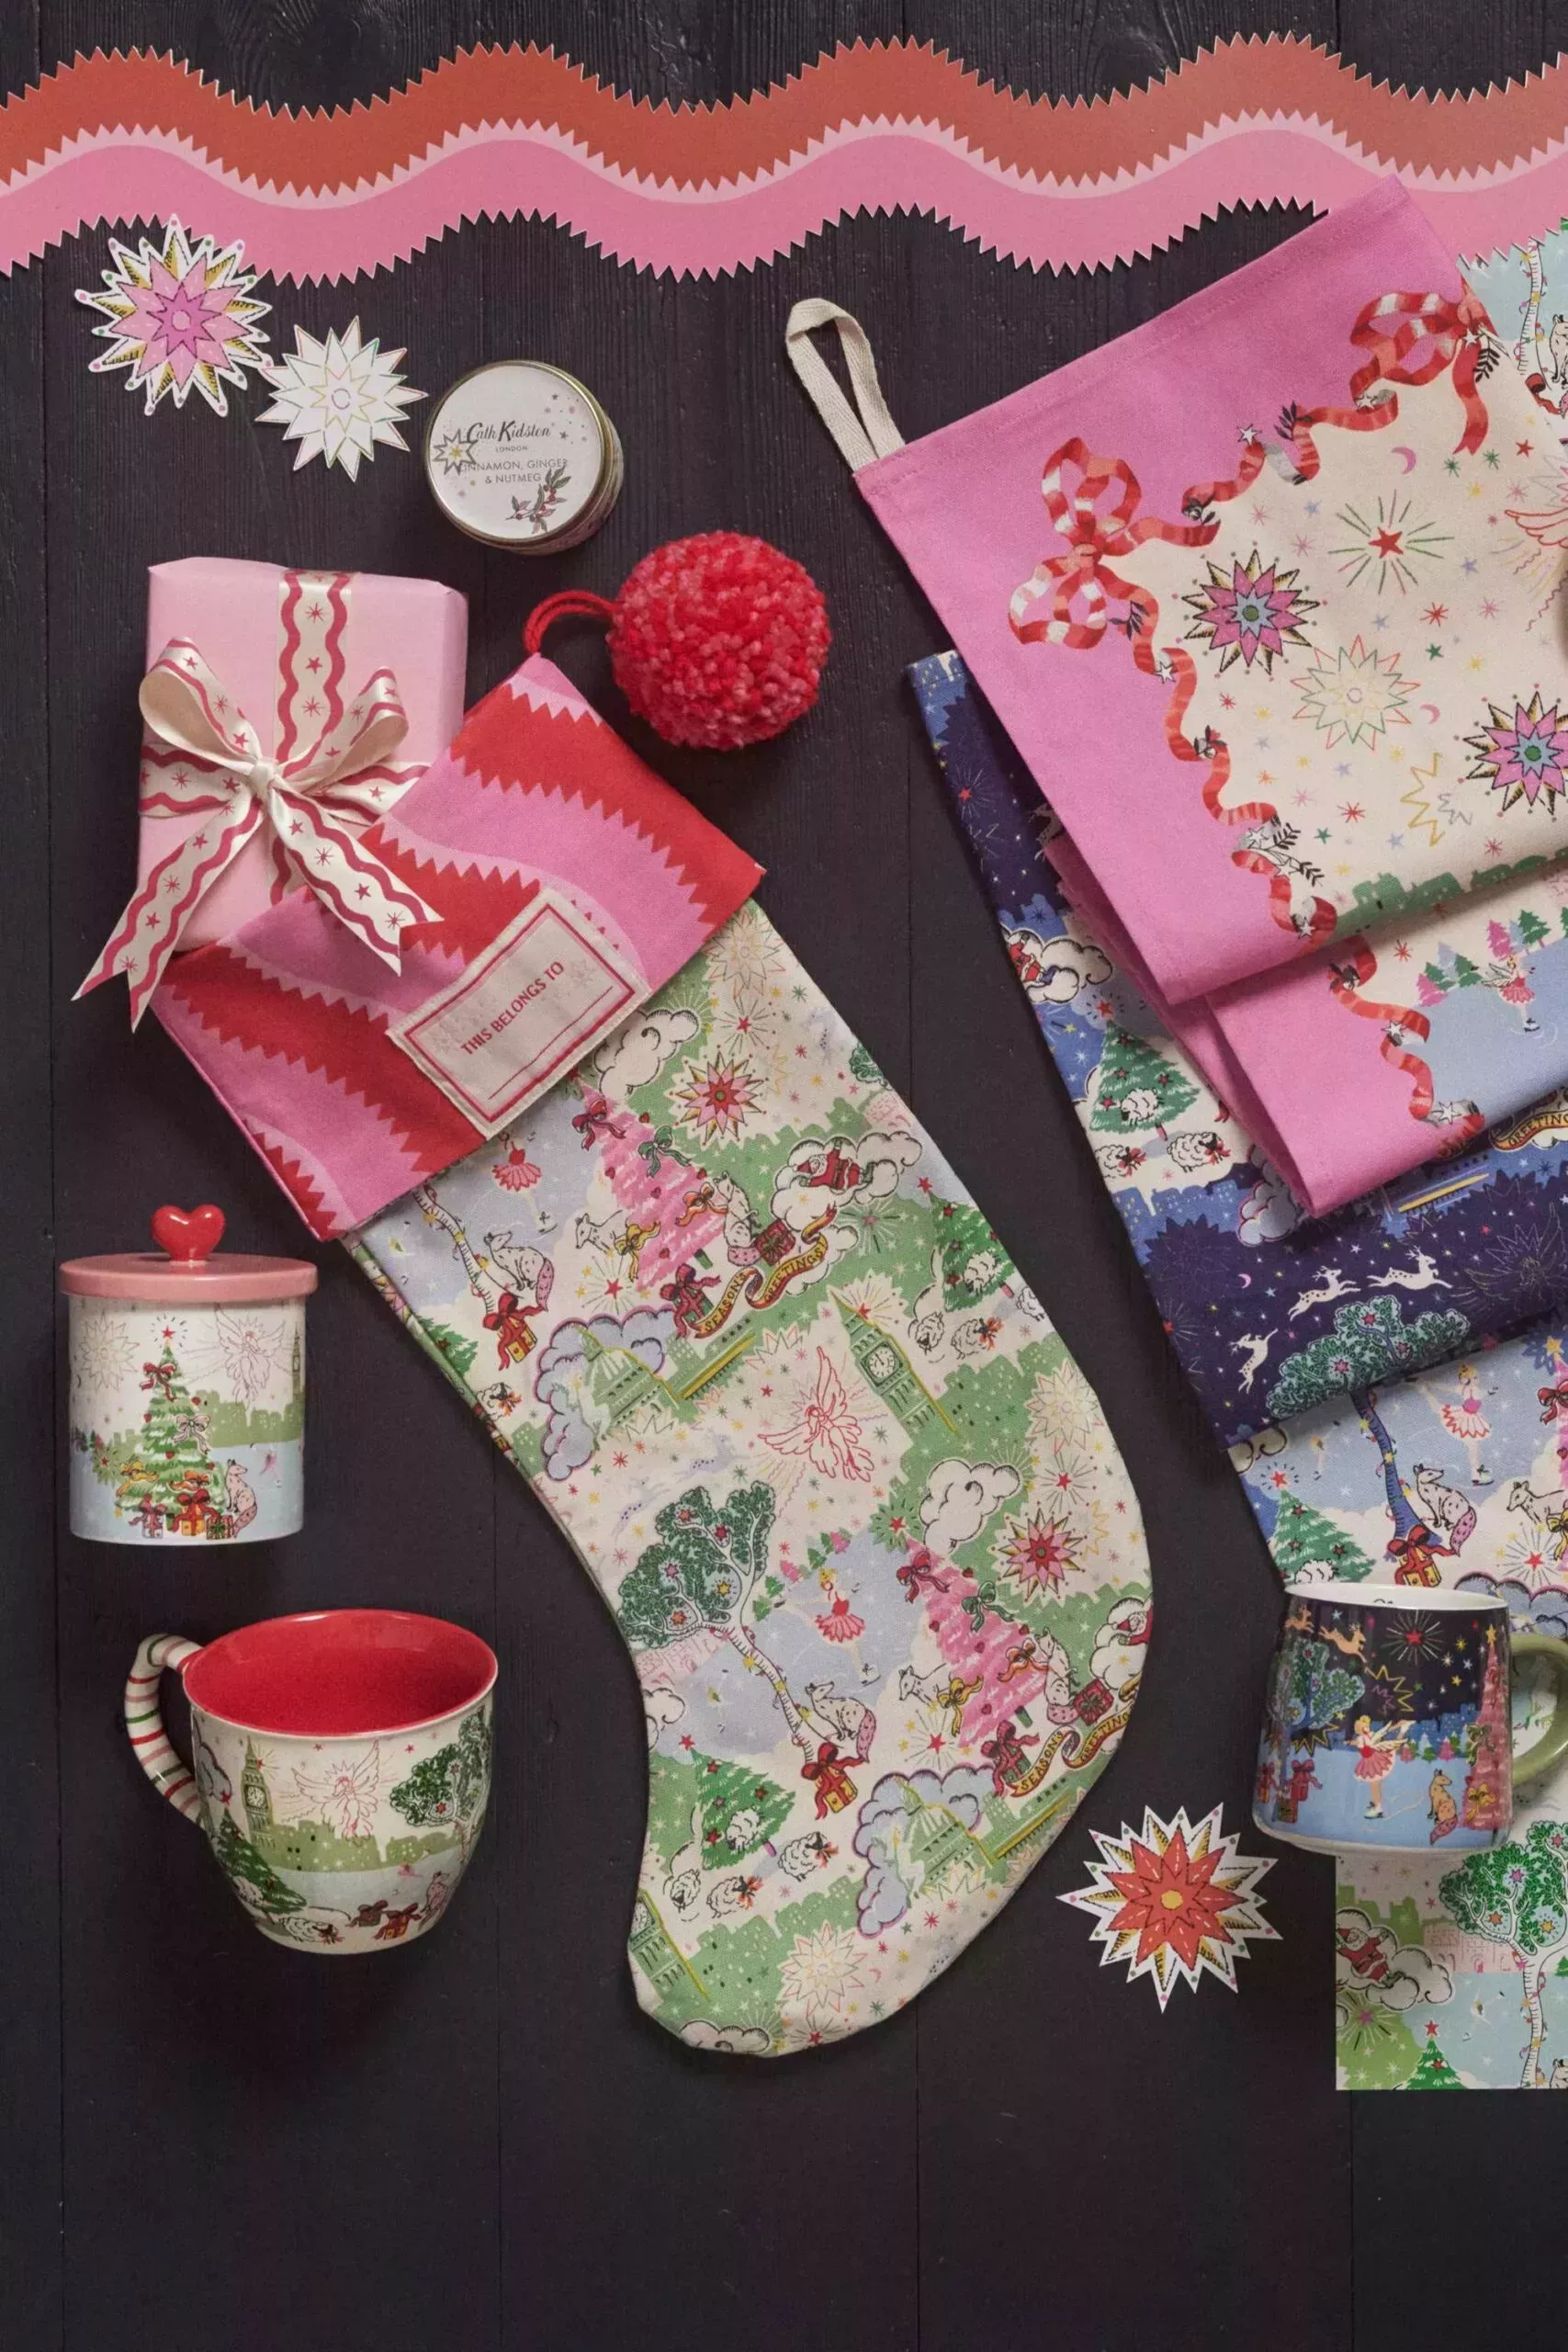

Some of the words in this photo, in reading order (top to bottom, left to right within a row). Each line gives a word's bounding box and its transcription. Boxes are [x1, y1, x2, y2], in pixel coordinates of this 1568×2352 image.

[467, 422, 497, 444] Cath
[498, 420, 550, 442] Kidston
[527, 458, 568, 469] GINGER
[485, 475, 491, 484] &
[496, 473, 541, 483] NUTMEG
[460, 1028, 492, 1055] THIS
[490, 978, 547, 1033] BELONGS
[544, 961, 564, 980] TO
